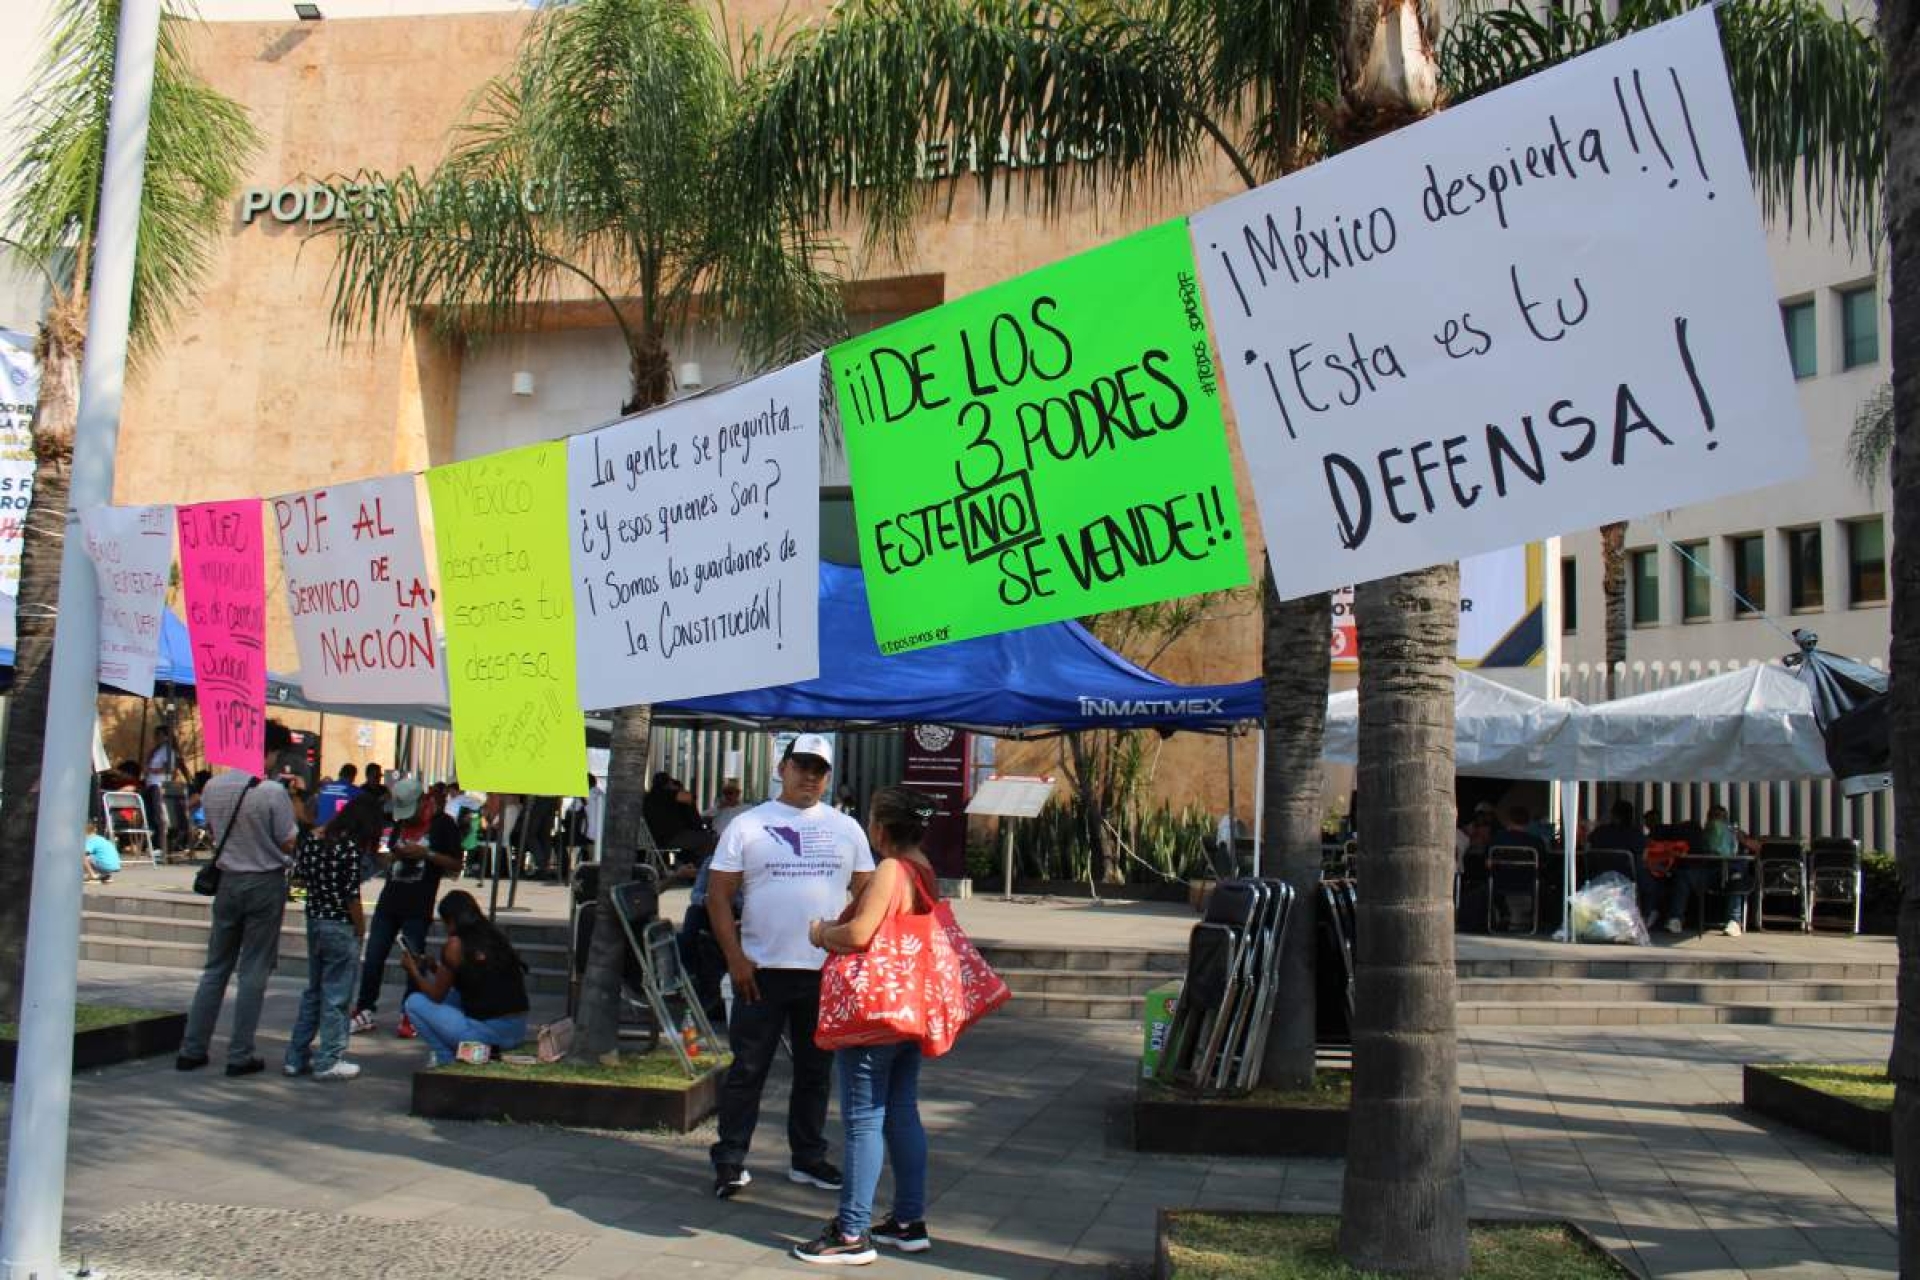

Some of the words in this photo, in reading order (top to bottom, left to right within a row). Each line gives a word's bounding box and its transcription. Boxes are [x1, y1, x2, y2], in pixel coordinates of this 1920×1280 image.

[1211, 205, 1397, 318] ¡México
[960, 295, 1073, 397] LOS
[1244, 332, 1406, 440] ¡Esta
[1434, 312, 1492, 359] es
[1511, 263, 1589, 343] tu
[955, 401, 1005, 492] 3
[1014, 348, 1189, 471] PODRES
[626, 428, 679, 491] gente
[692, 433, 713, 465] se
[352, 498, 395, 540] AL
[618, 512, 652, 543] esos
[659, 491, 718, 543] quienes
[875, 498, 960, 575] ESTE
[967, 492, 1029, 550] NO
[288, 578, 360, 617] SERVICIO
[370, 556, 390, 582] DE
[396, 578, 429, 610] LA
[669, 556, 689, 590] los
[695, 540, 771, 594] guardianes
[780, 529, 798, 562] de
[998, 536, 1056, 606] SE
[320, 612, 436, 677] NACIÓN
[1078, 696, 1224, 716] INMATMEX
